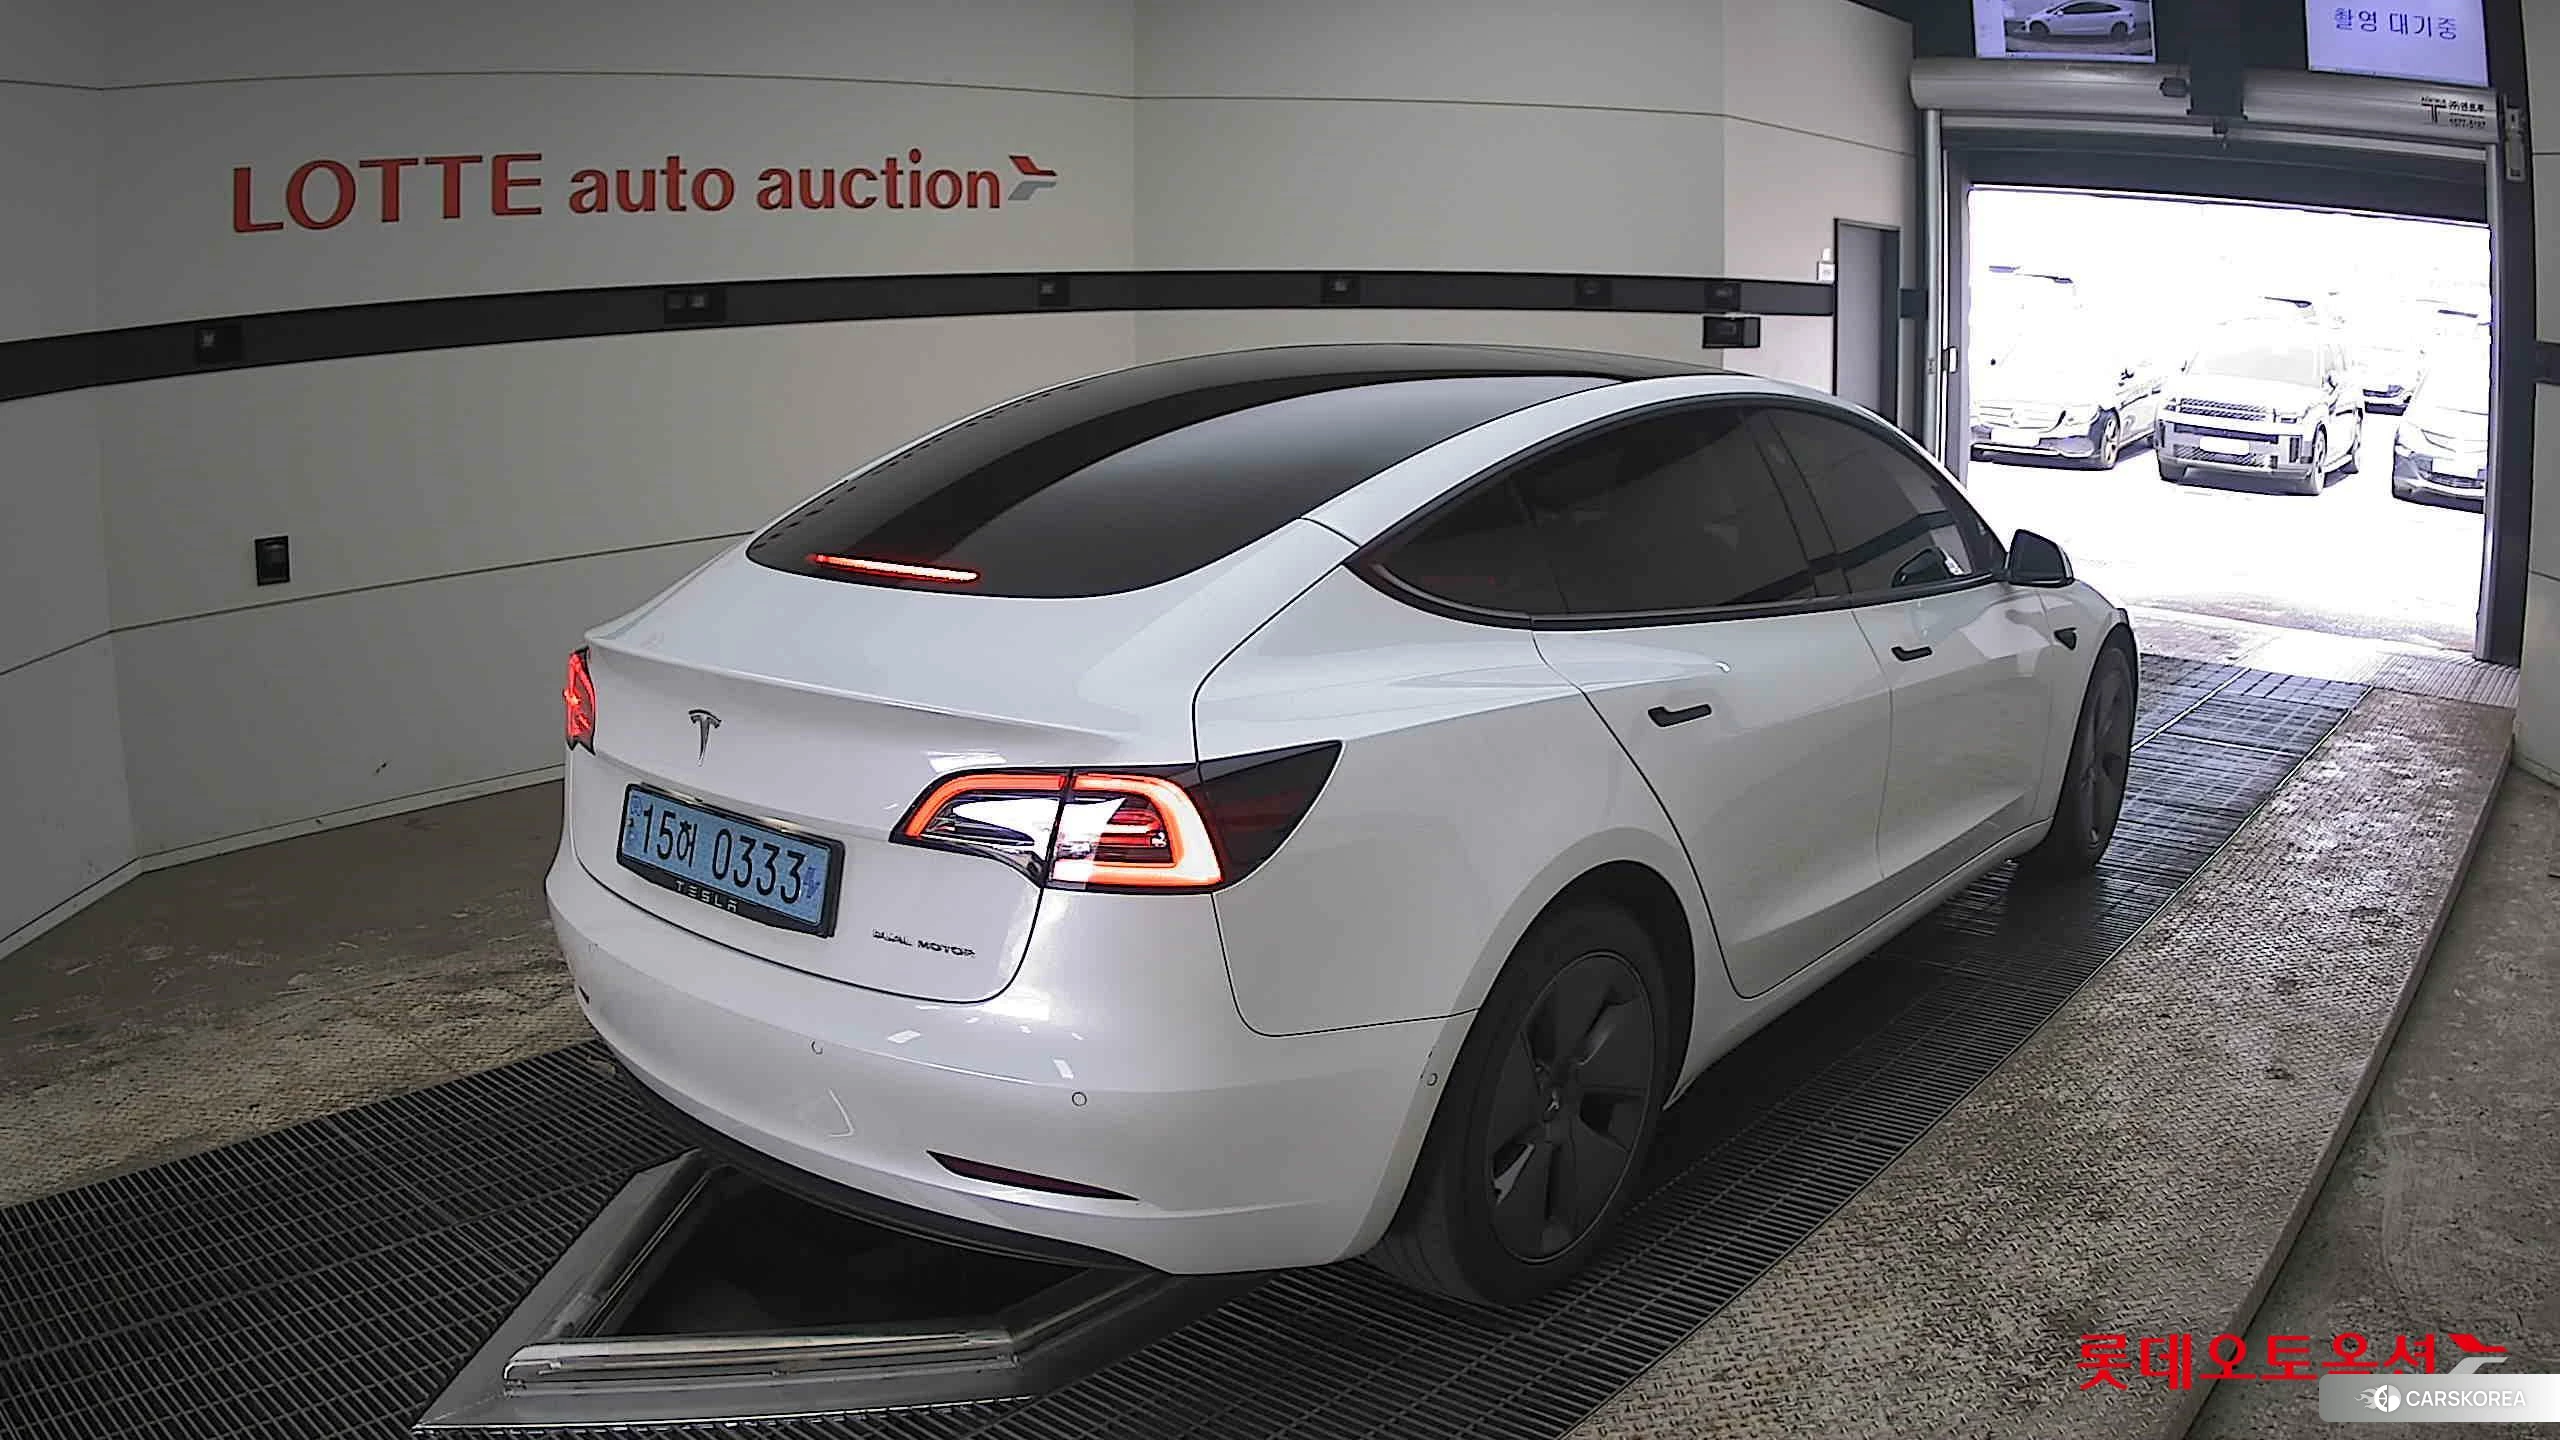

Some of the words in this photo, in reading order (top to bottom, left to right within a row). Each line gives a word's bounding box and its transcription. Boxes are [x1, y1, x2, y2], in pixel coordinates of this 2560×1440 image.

[2336, 7, 2378, 33] 촬영
[2389, 13, 2457, 40] 대기중
[233, 153, 542, 233] LOTTE
[568, 154, 735, 214] auto
[756, 148, 1001, 210] auction
[643, 804, 698, 868] 15허
[712, 828, 806, 904] 0333
[676, 880, 737, 913] TESLA
[873, 930, 912, 947] DUAL
[918, 940, 976, 957] MOTOR
